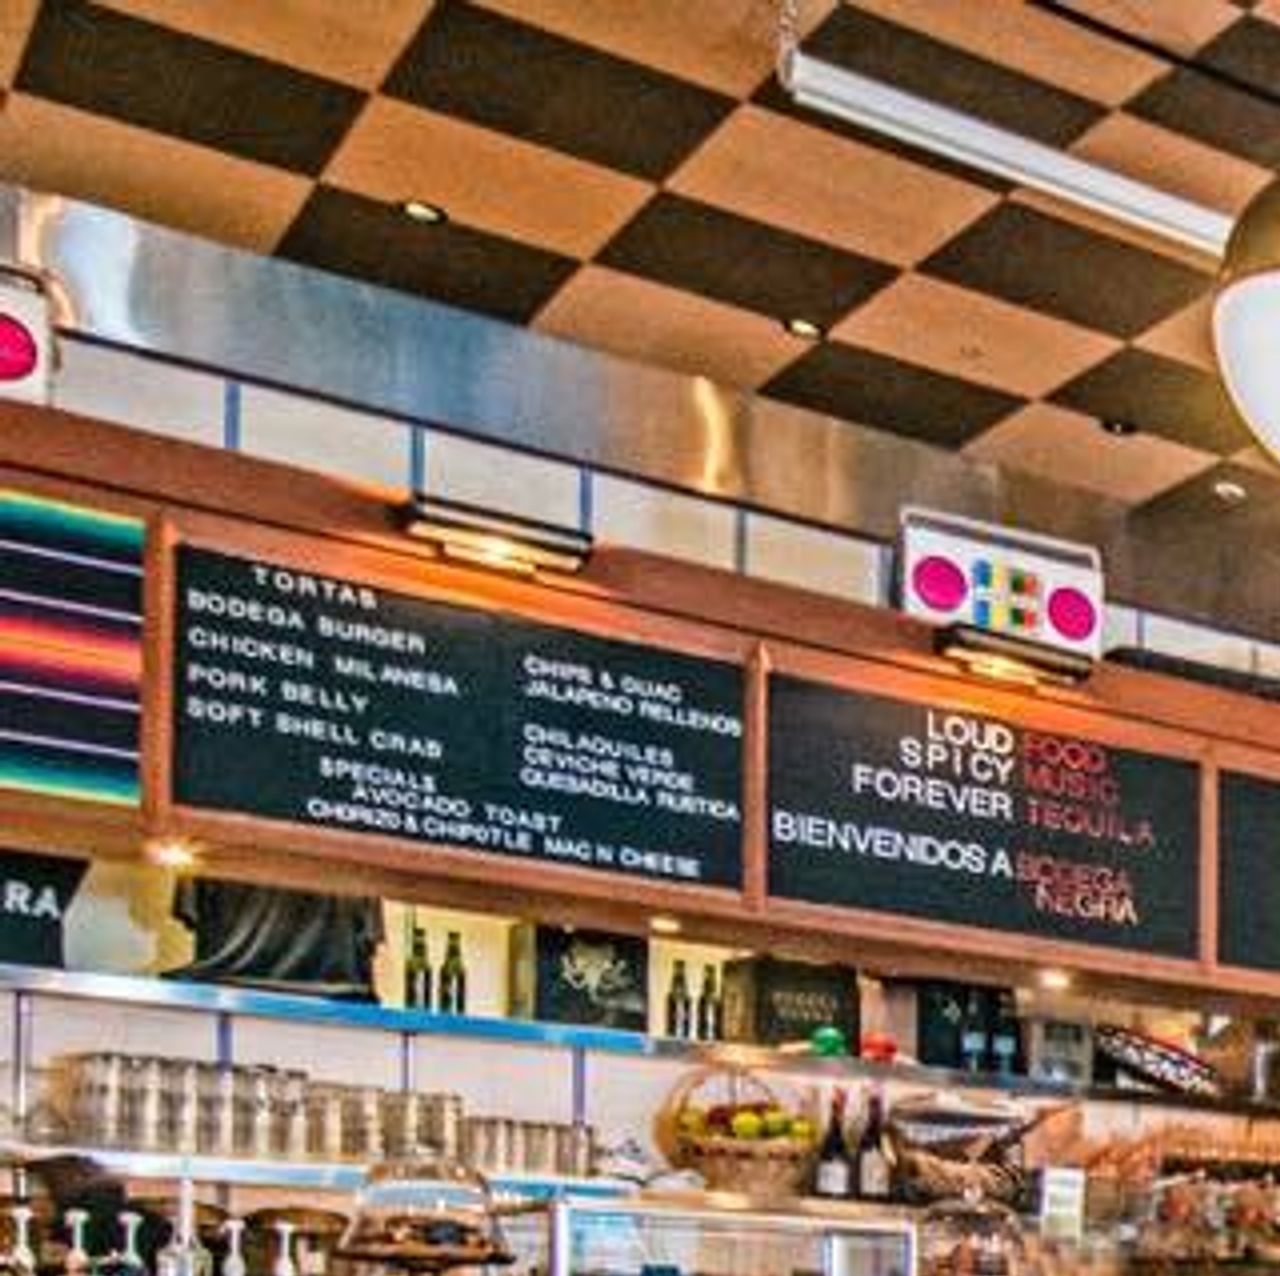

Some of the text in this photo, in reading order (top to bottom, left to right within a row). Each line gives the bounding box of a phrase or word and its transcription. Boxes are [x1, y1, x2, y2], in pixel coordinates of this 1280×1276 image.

[253, 566, 378, 610] TORTAS
[188, 587, 426, 655] BODEGA BURGER
[188, 627, 314, 669] CHICKEN
[187, 662, 369, 713] PORK BELLY
[186, 696, 442, 759] SOFT SHELL CRAB
[927, 710, 1105, 772] LOUD FOOD
[319, 757, 437, 794] SPECIALS
[900, 737, 1120, 804] SPICY MUSIC
[352, 785, 562, 834] AVOCADO TOAST
[852, 763, 1153, 846] FOREVER TEQUILA
[544, 835, 591, 862] MAC
[595, 842, 614, 864] N
[772, 810, 986, 874] BIENVENIDOS
[990, 847, 1013, 878] A
[4, 880, 61, 918] RA
